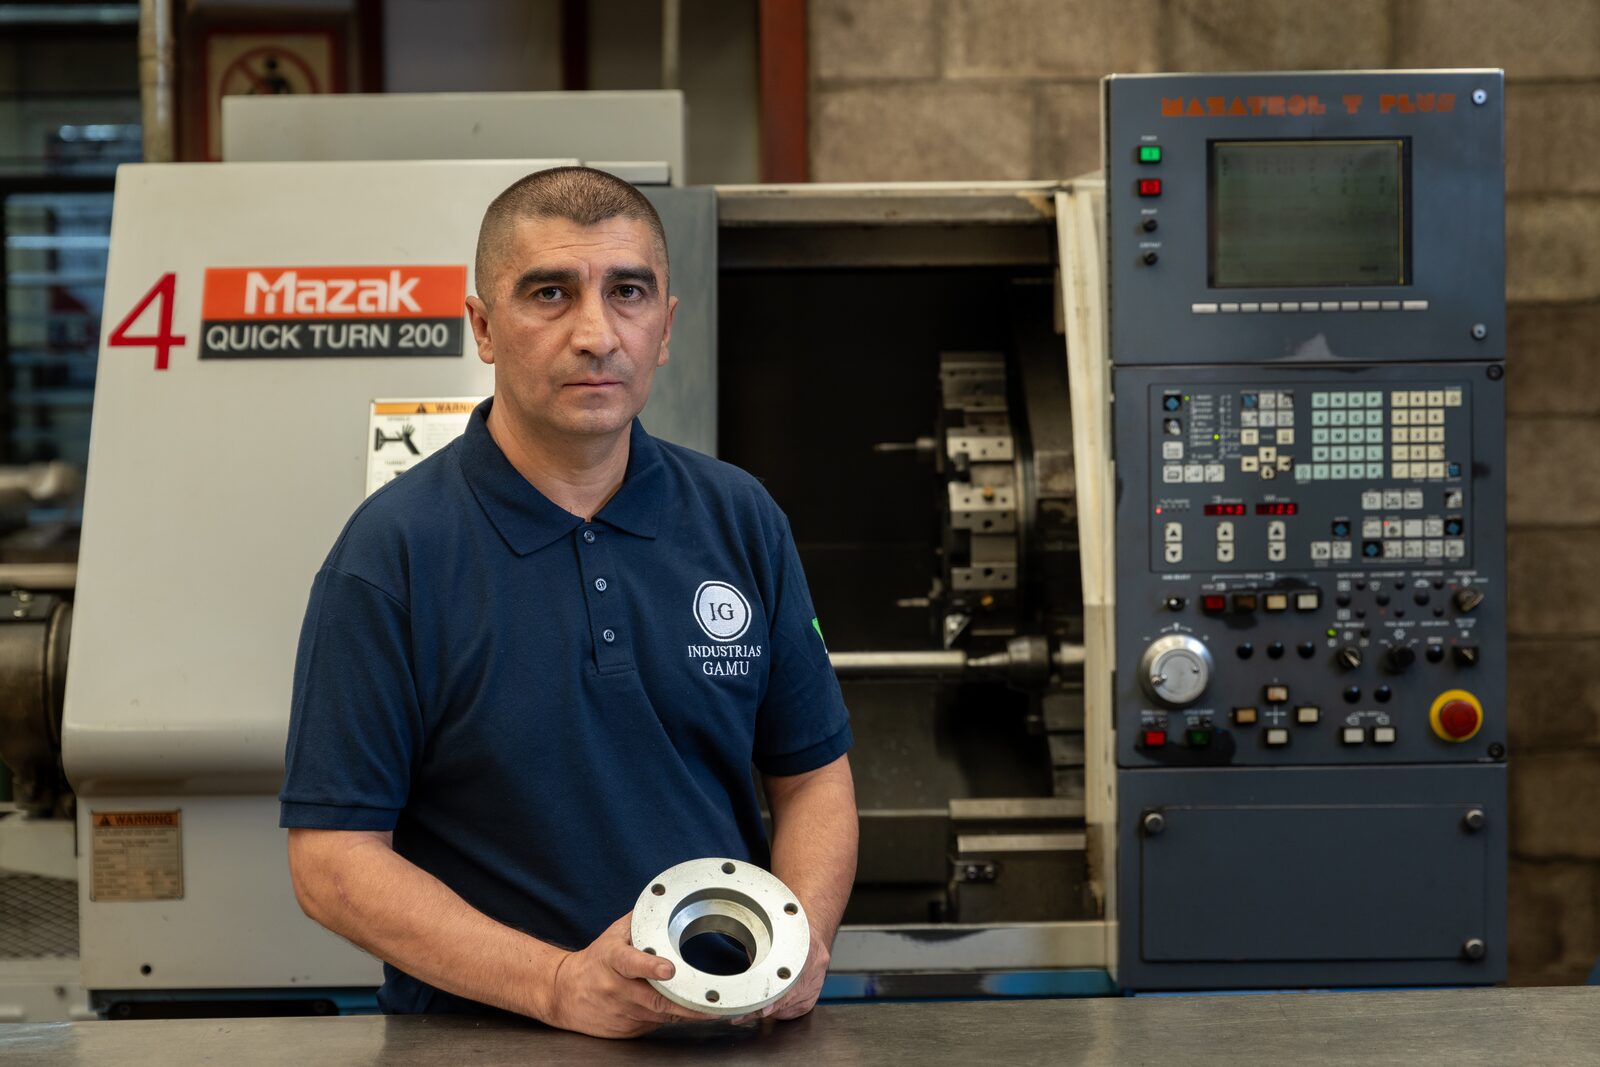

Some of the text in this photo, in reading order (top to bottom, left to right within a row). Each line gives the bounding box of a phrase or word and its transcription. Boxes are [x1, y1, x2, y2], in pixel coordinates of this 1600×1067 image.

[1379, 93, 1457, 114] PLUS
[244, 270, 422, 315] Mazak
[108, 272, 186, 371] 4
[206, 323, 449, 350] QUICK TURN 200
[708, 602, 735, 622] IG
[687, 645, 762, 658] INDUSTRIAS
[702, 660, 750, 676] GAMU
[115, 815, 173, 825] WARNING
